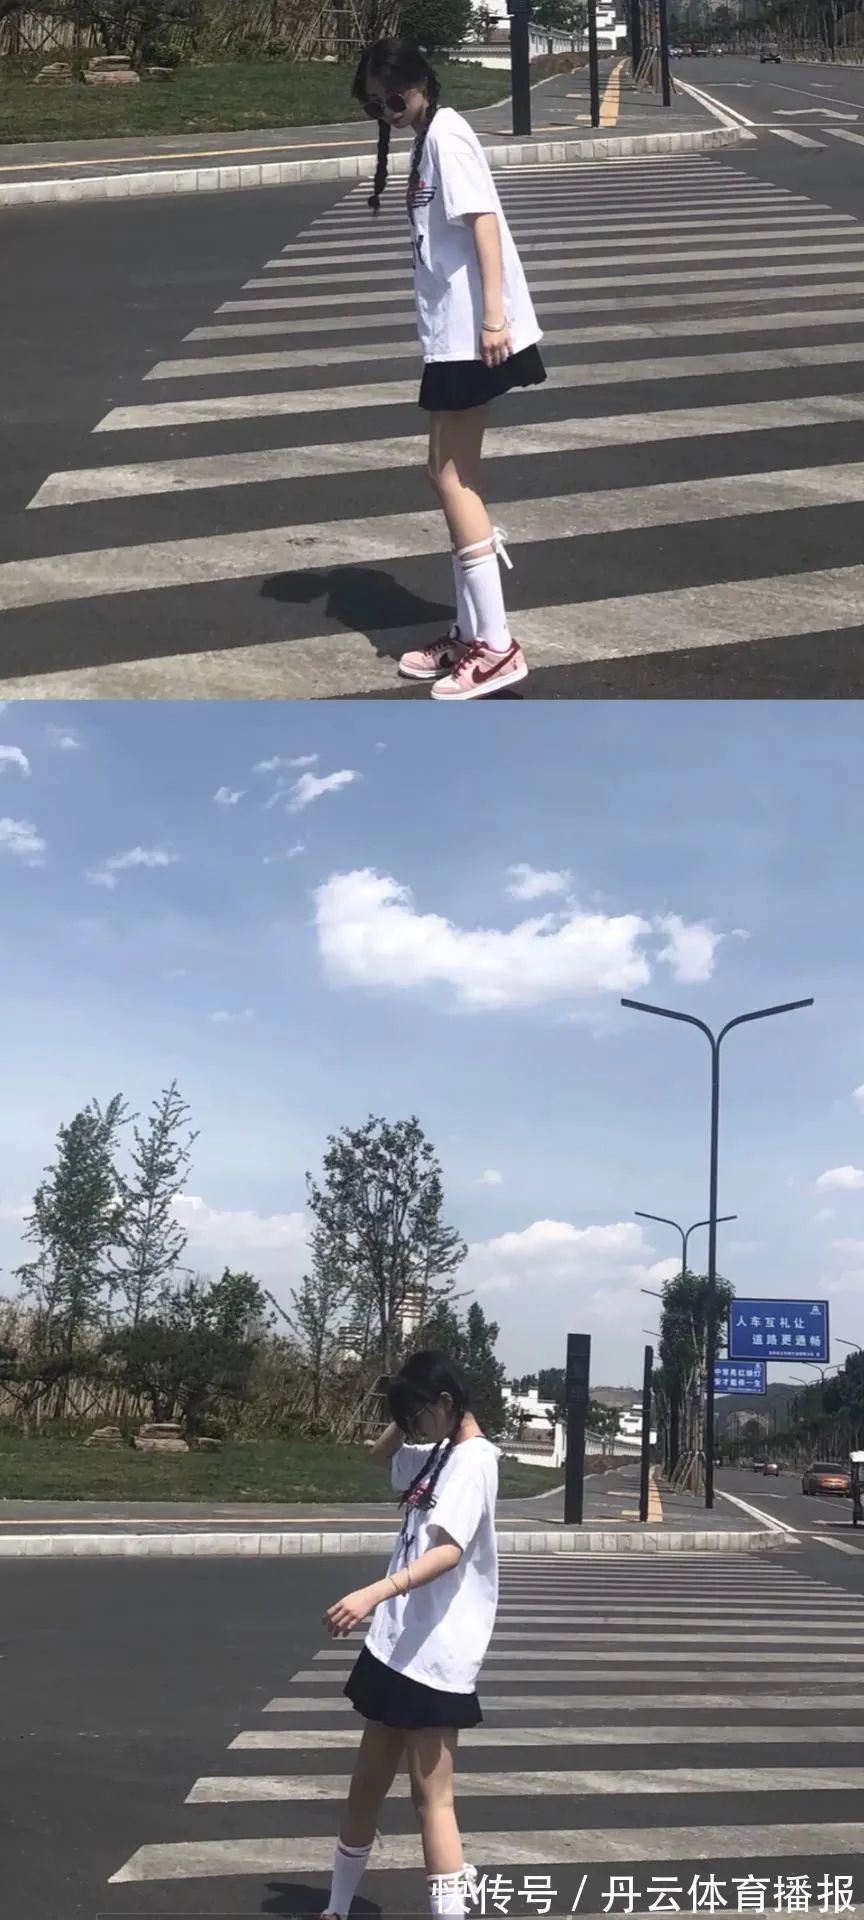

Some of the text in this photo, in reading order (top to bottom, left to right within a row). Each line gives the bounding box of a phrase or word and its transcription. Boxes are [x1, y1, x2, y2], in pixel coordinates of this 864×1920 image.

[736, 1316, 805, 1329] 人车互礼让
[752, 1334, 821, 1347] 道路更通畅
